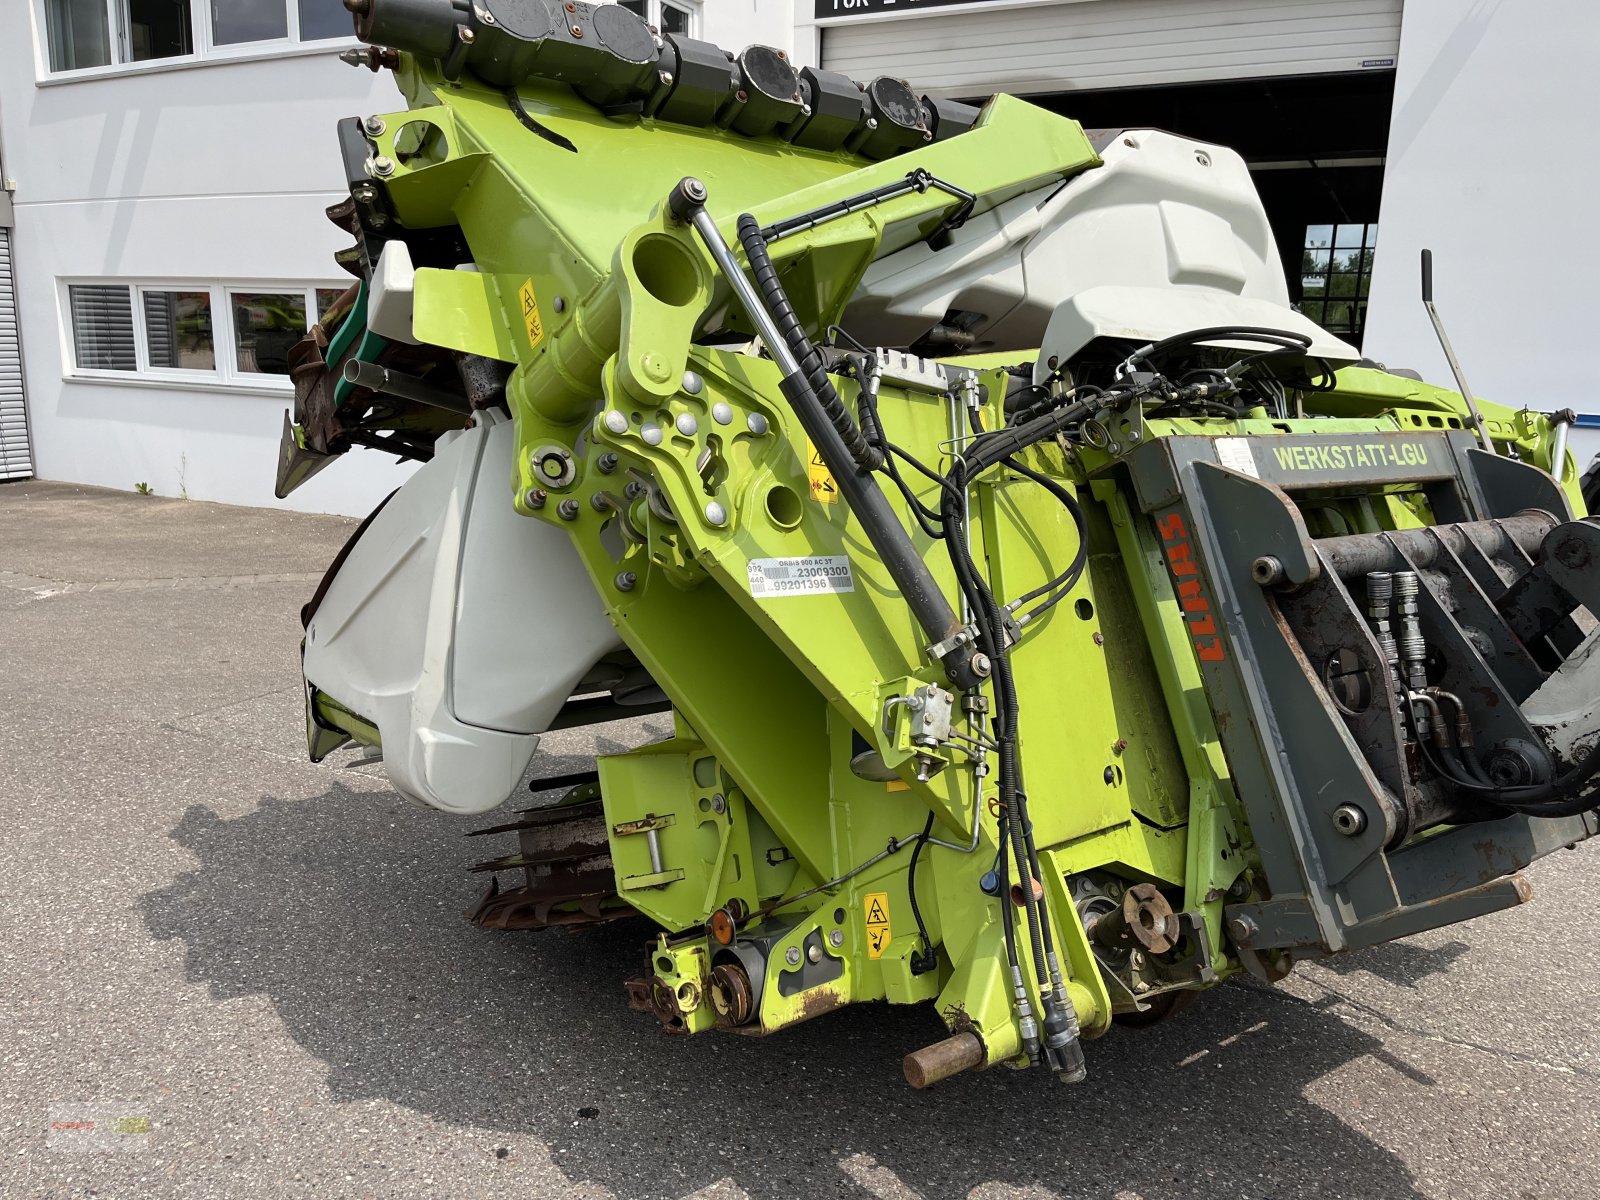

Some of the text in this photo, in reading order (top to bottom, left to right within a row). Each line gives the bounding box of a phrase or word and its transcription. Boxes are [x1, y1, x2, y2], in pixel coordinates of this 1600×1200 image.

[1273, 443, 1428, 471] WERKSTATT-LGU
[797, 566, 848, 578] 23009300
[773, 579, 827, 591] 99201396
[1158, 513, 1225, 661] CLAAS
